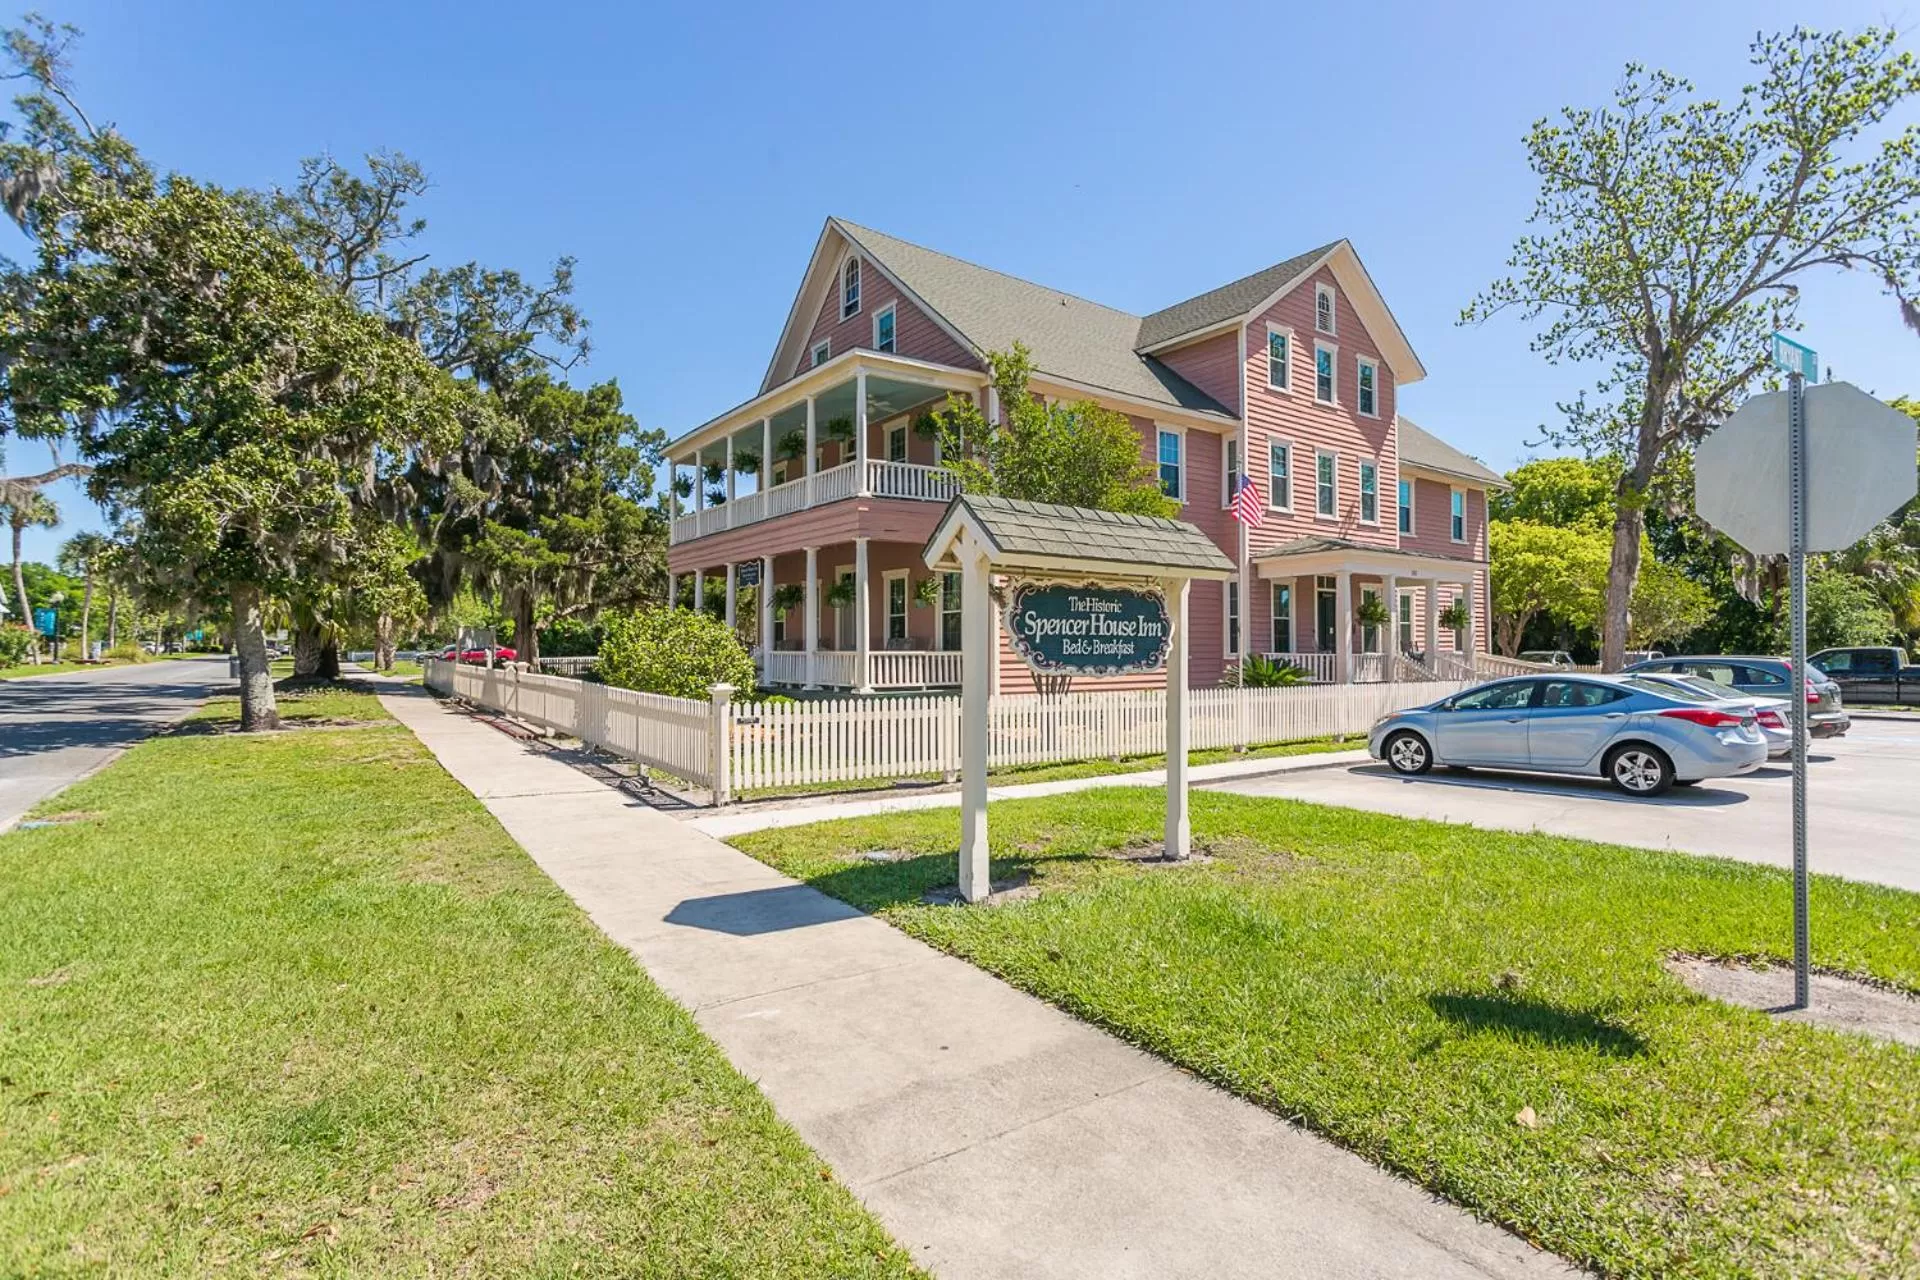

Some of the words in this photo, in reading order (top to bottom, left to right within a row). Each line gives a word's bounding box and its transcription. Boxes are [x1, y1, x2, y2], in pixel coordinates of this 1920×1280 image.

[1068, 596, 1086, 612] The
[1085, 597, 1122, 613] Historic
[1024, 610, 1090, 643] Spencer
[1089, 613, 1137, 636] House
[1137, 615, 1162, 637] Inn
[1063, 639, 1082, 655] Bed
[1092, 639, 1135, 660] Breakfast
